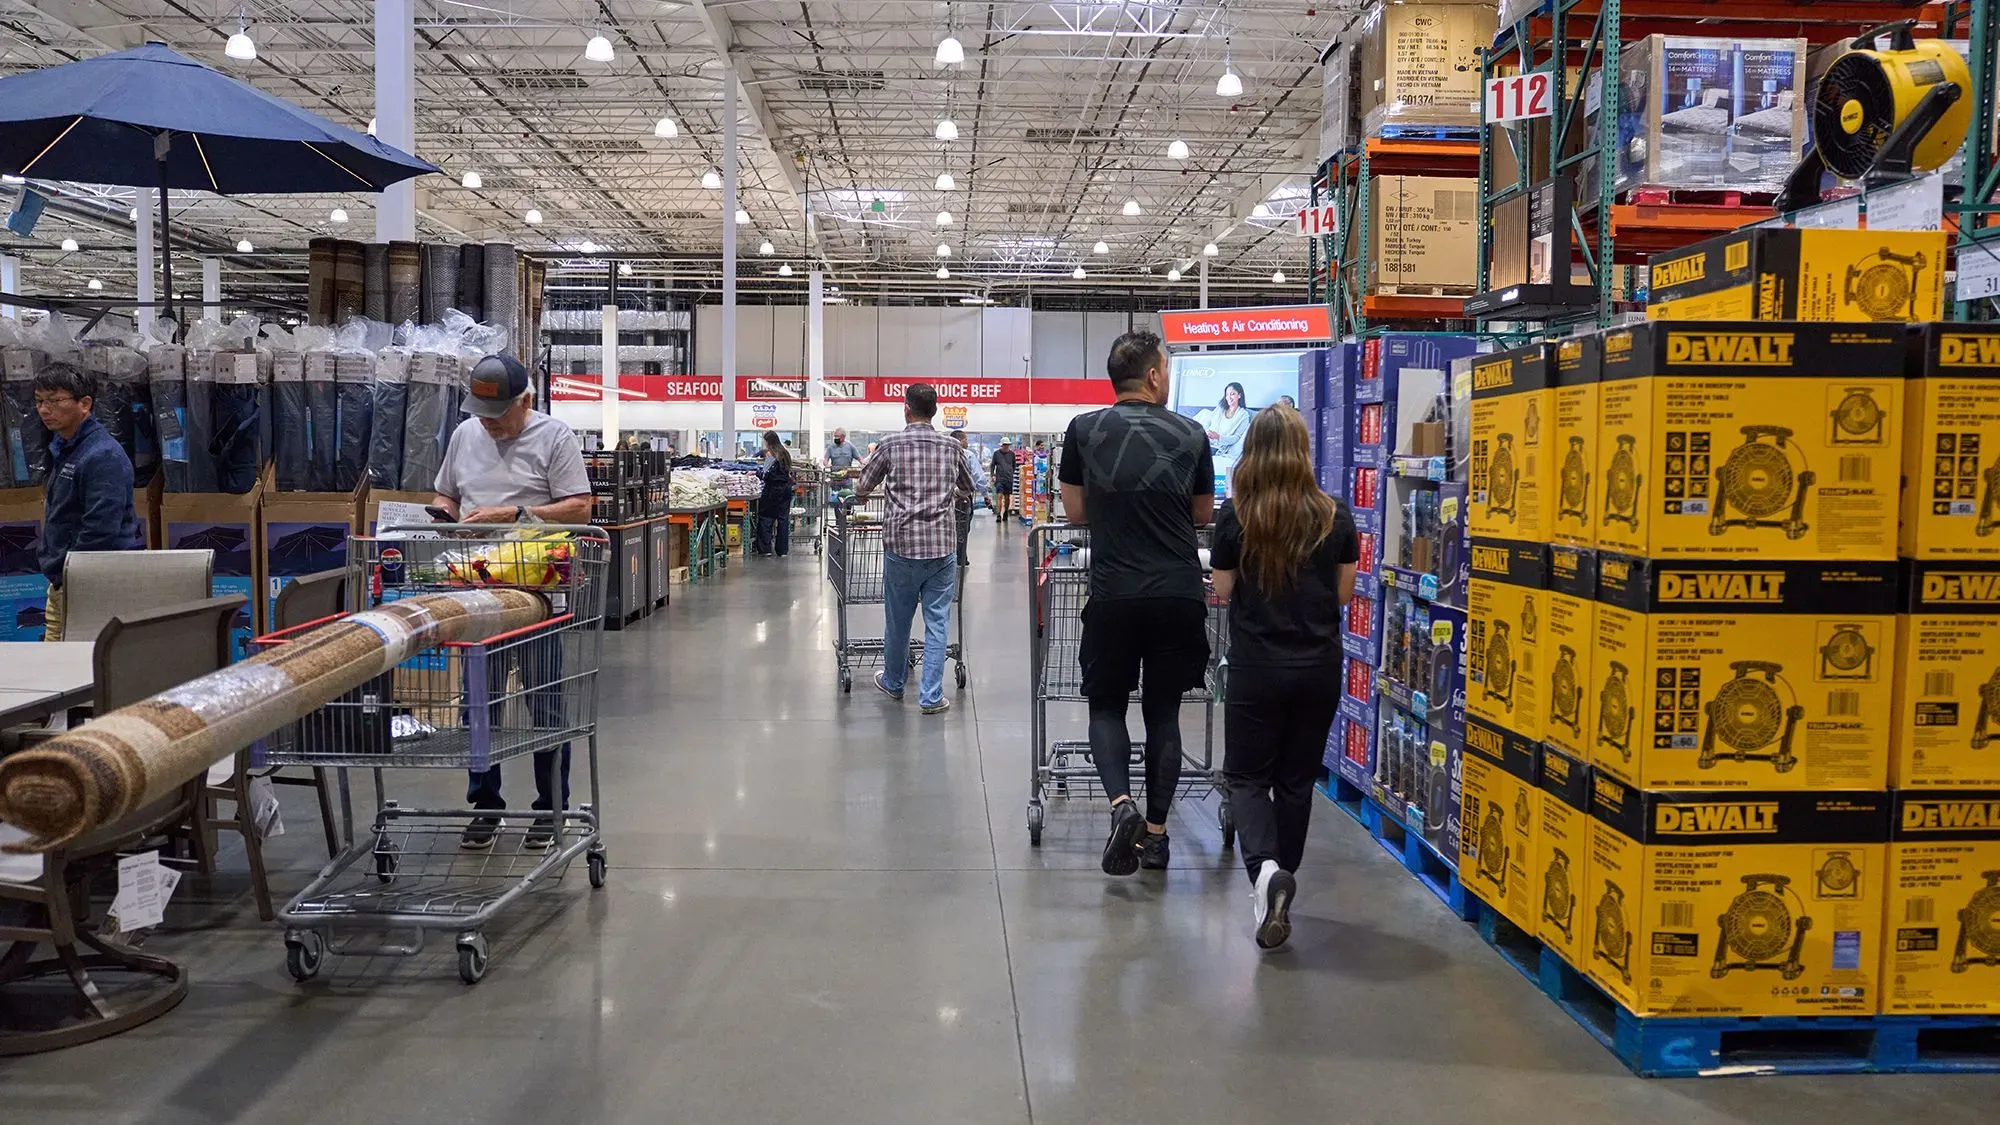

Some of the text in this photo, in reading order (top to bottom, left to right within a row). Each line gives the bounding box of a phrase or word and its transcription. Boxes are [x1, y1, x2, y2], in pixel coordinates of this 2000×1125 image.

[1415, 18, 1432, 26] CWC
[1757, 68, 1791, 76] MATTRESS
[1491, 74, 1548, 120] 112
[1298, 207, 1335, 234] 114
[1652, 253, 1706, 290] DEWALT
[1760, 272, 1776, 320] EWALT
[1183, 319, 1308, 336] Heating & Air Conditioning
[1668, 334, 1794, 365] DEWALT
[1940, 335, 2000, 366] DEW
[1182, 368, 1212, 377] LENNOX
[1475, 359, 1513, 391] DEWALT
[667, 382, 723, 396] SEAFOO
[824, 383, 859, 397] EAT
[971, 385, 1002, 398] BEEF
[1472, 546, 1510, 575] DEWALT
[1659, 571, 1785, 603] DEWALT
[1922, 572, 2000, 603] DEWA
[1466, 722, 1504, 761] DEWALT
[1656, 803, 1778, 834] DEWALT
[1903, 801, 2000, 832] DEWA
